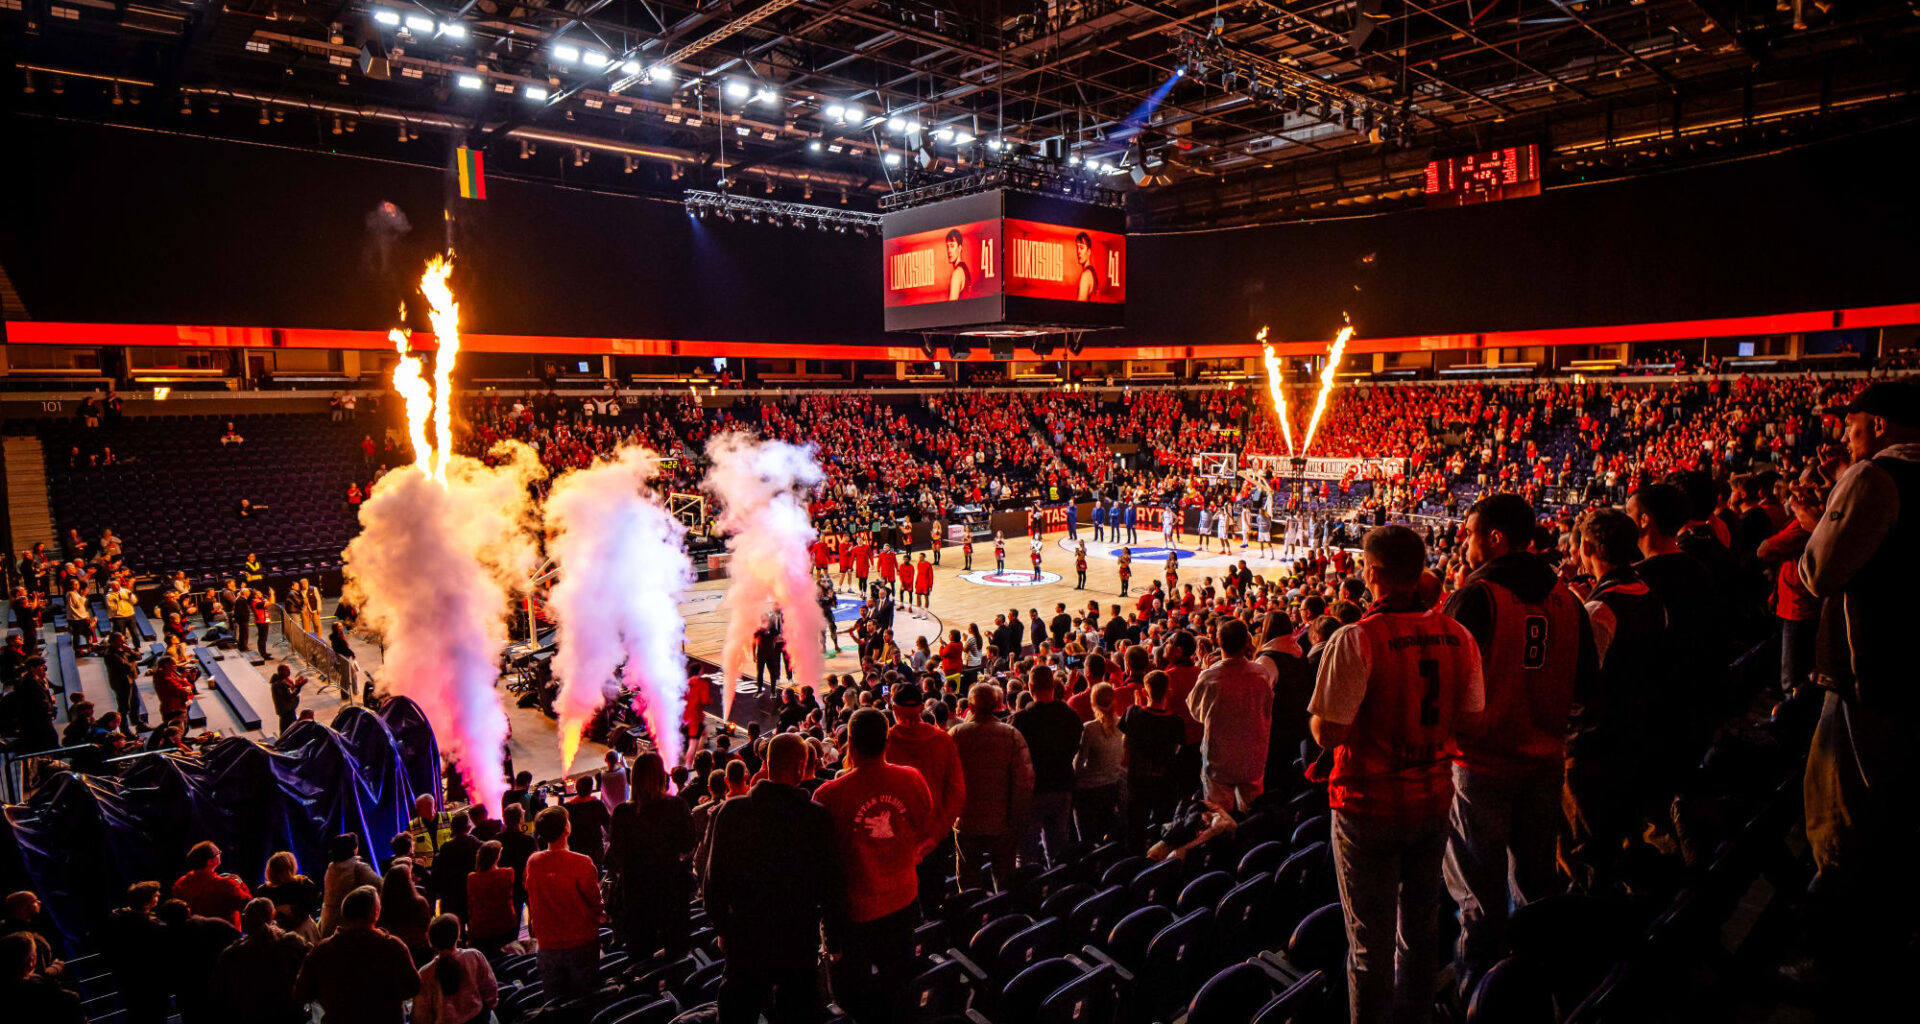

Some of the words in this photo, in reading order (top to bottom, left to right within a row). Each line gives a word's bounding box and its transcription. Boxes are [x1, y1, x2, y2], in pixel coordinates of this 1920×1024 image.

[980, 238, 995, 279] 41
[1107, 250, 1120, 287] 41
[40, 401, 62, 412] 101
[1135, 506, 1185, 525] RYTS
[1523, 614, 1548, 670] 8
